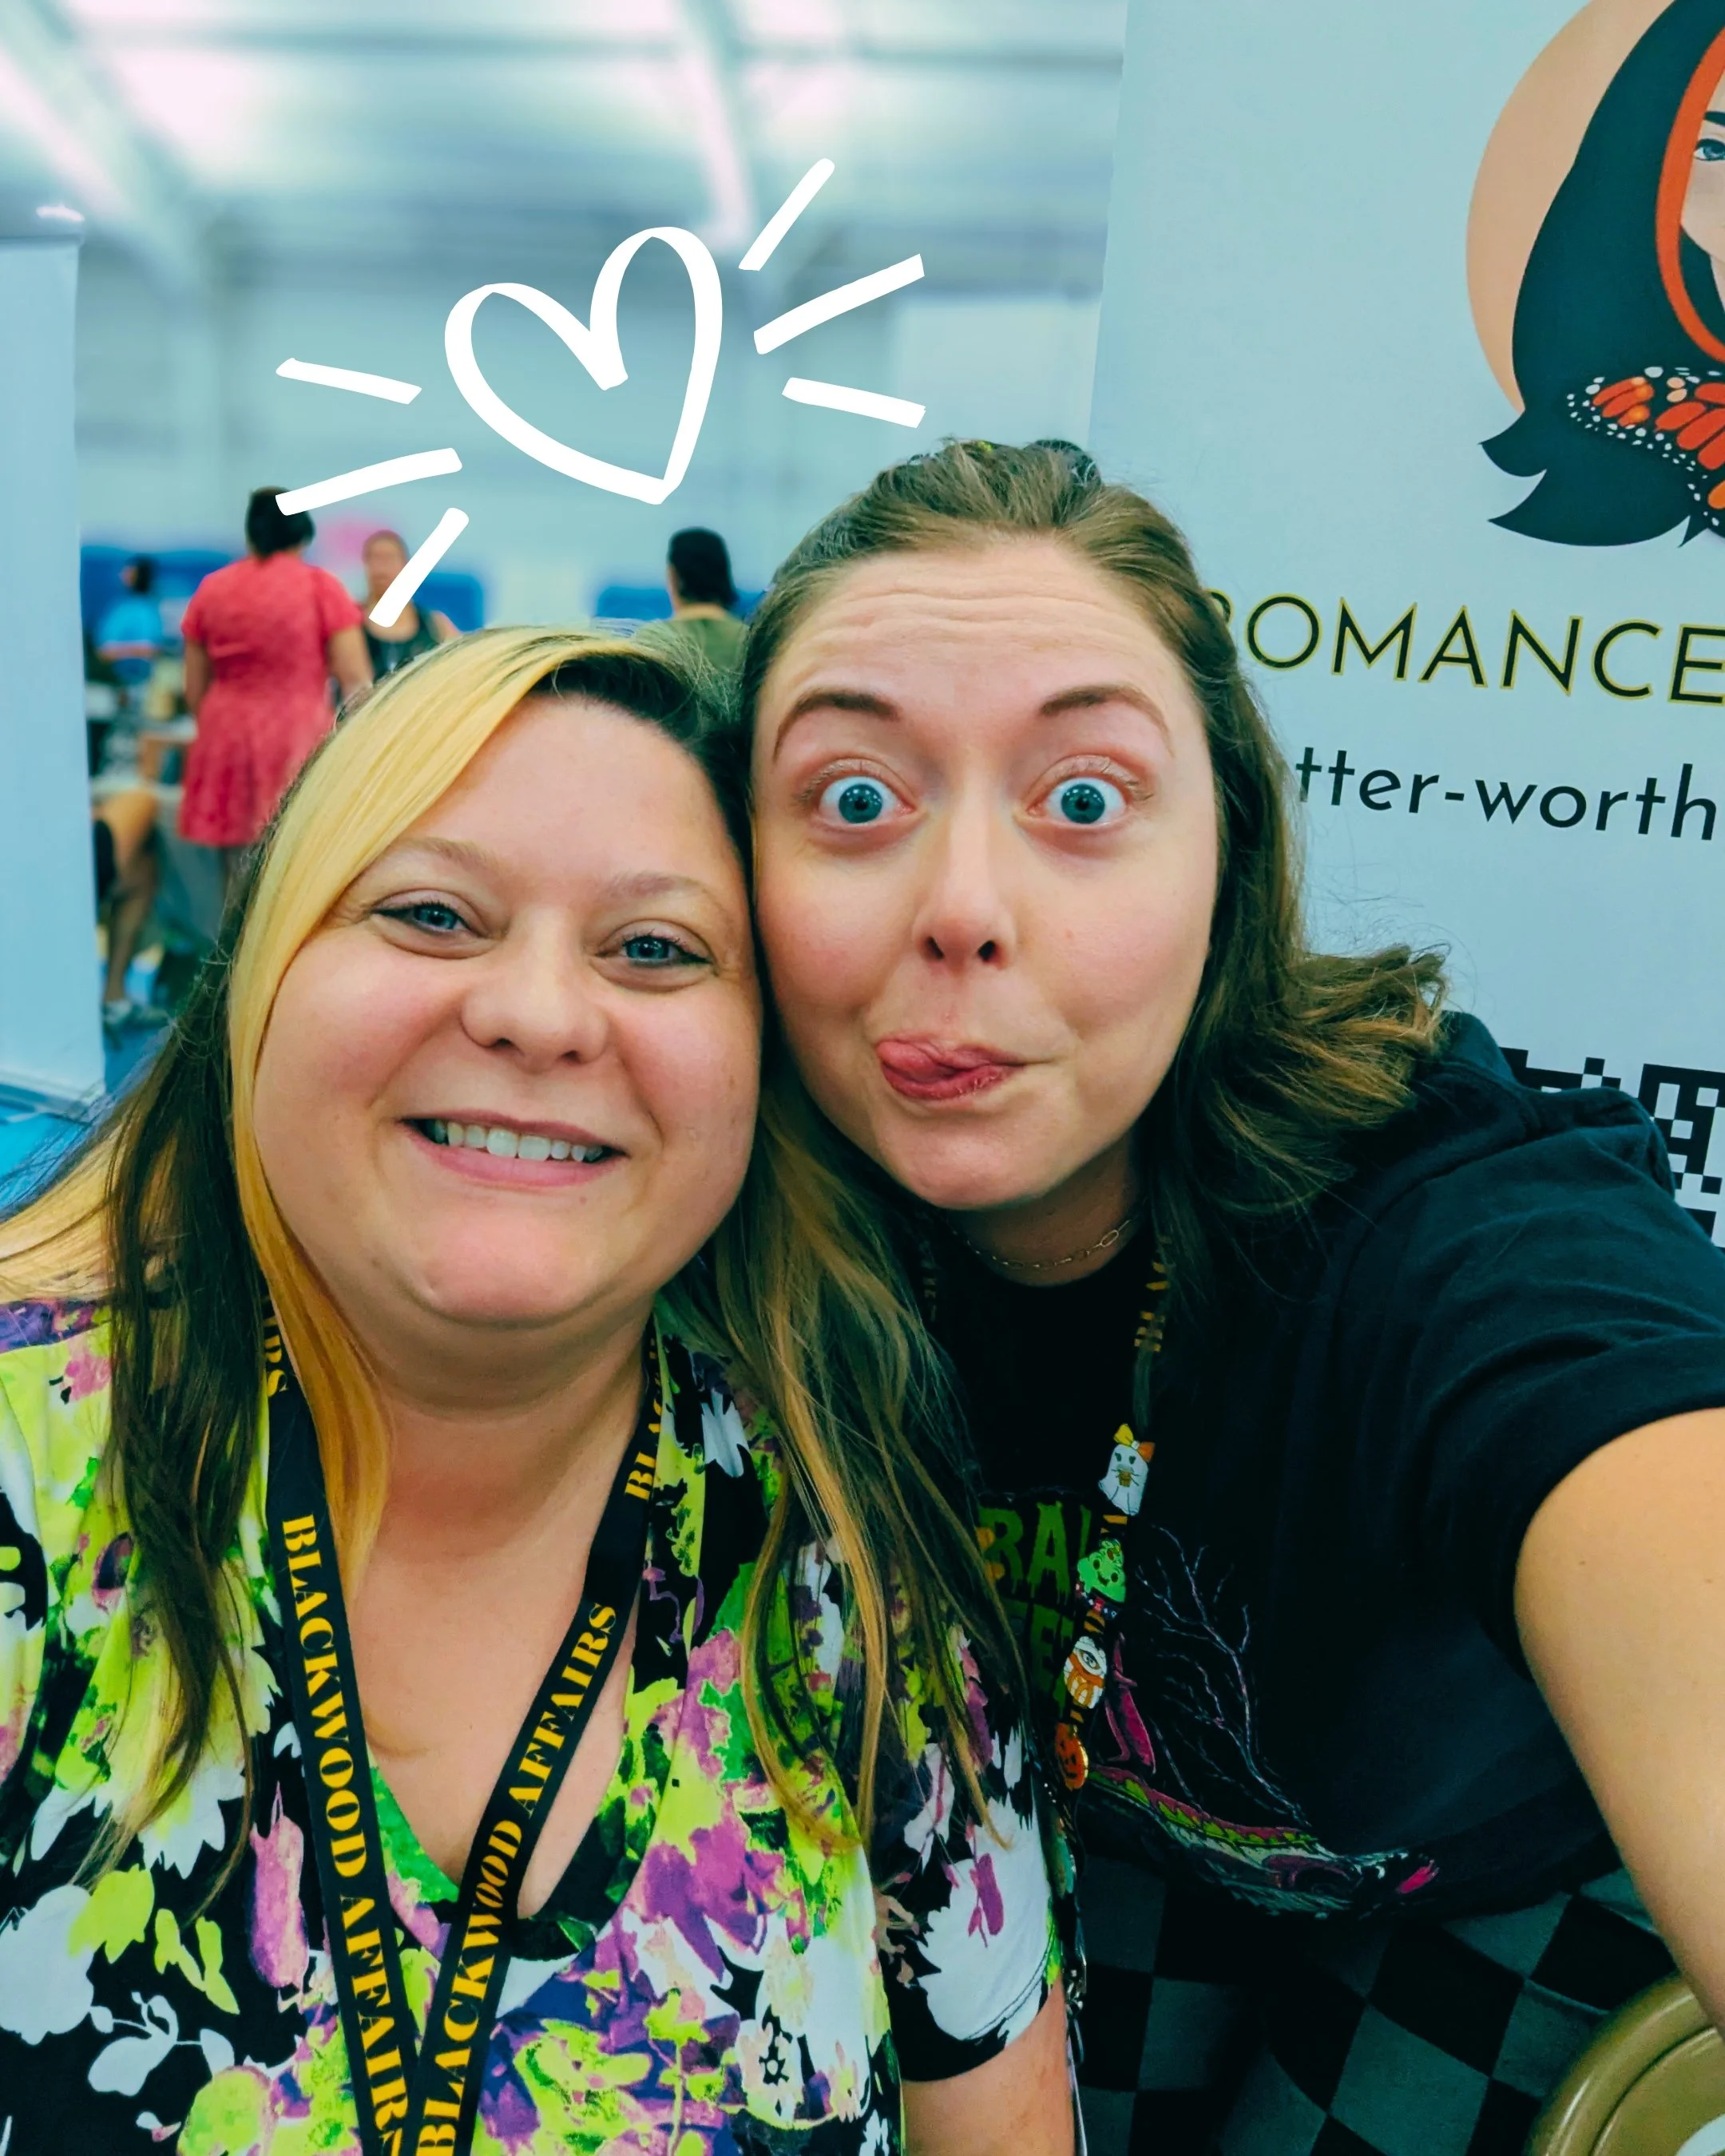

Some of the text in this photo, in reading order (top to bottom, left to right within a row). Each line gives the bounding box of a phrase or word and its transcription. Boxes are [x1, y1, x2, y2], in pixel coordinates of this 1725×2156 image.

[281, 1514, 367, 1877] BLACKWOOD
[414, 1603, 617, 2156] BLACKWOOD AFFAIRS
